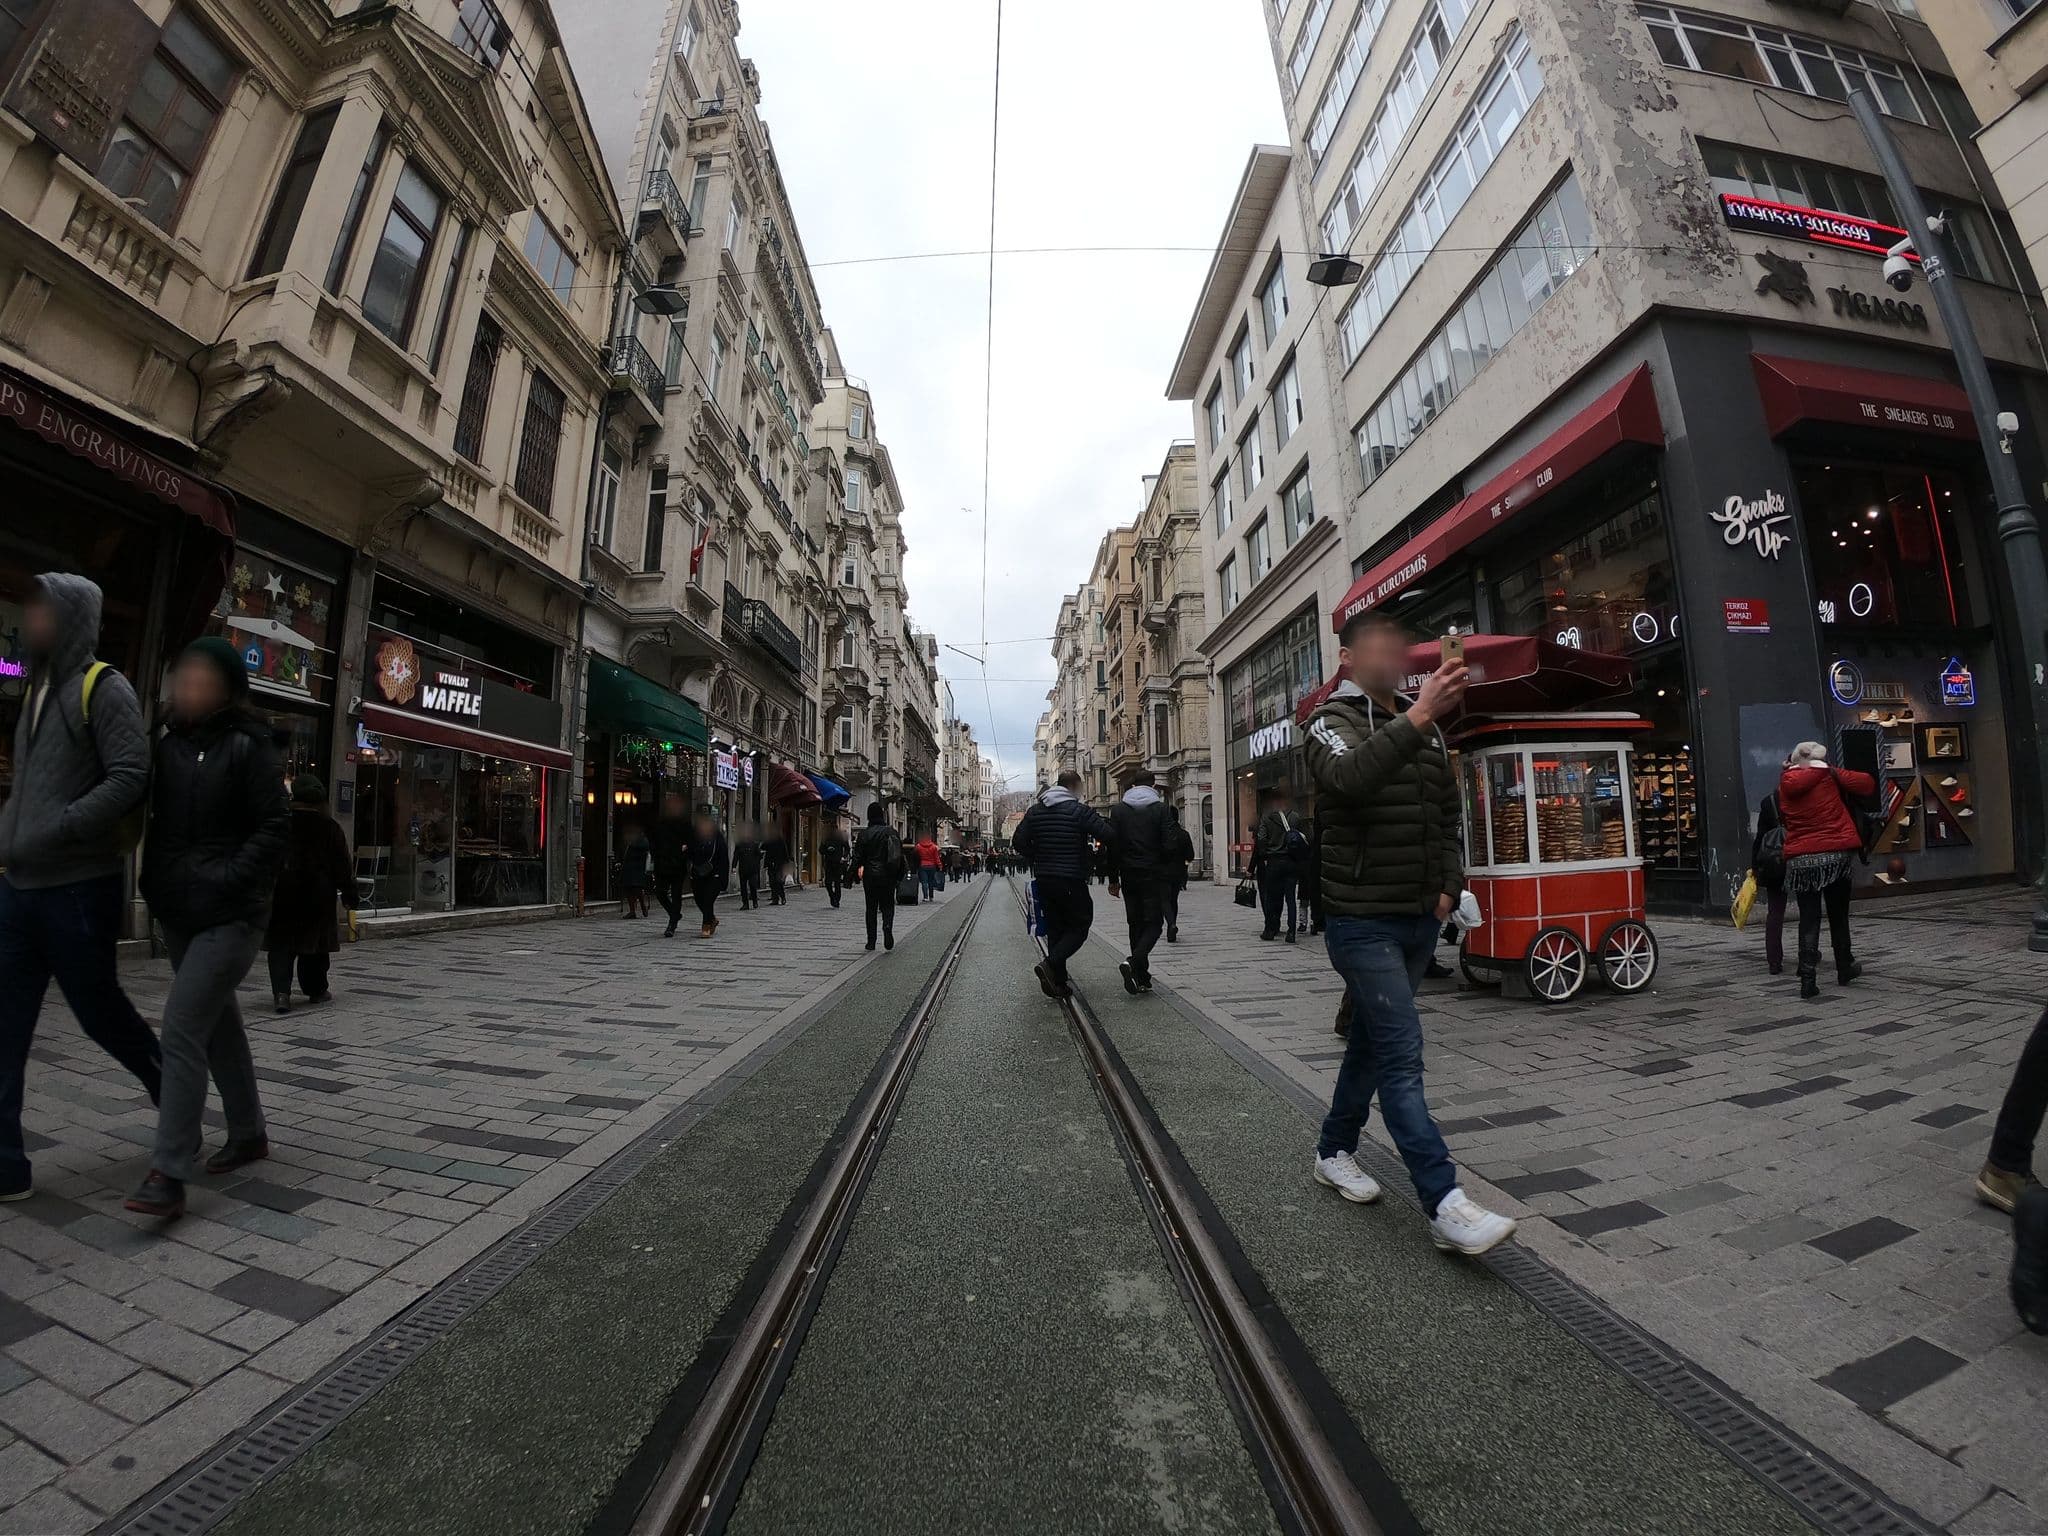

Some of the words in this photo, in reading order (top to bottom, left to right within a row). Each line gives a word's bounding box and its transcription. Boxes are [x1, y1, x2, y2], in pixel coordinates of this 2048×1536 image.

[1859, 402, 1879, 418] THE
[1884, 406, 1928, 426] SNEAKERS
[1933, 413, 1955, 429] CLUB
[38, 404, 181, 497] ENGRAVINGS
[1536, 467, 1553, 488] CLUB
[1490, 502, 1502, 519] THE
[1707, 489, 1785, 545] Sneaks
[1747, 516, 1792, 560] Up
[1377, 554, 1428, 598] KURUYEMİŞ
[0, 657, 28, 678] books
[437, 671, 469, 688] VIVALDI
[422, 685, 482, 716] WAFFLE
[717, 764, 738, 783] TYROS
